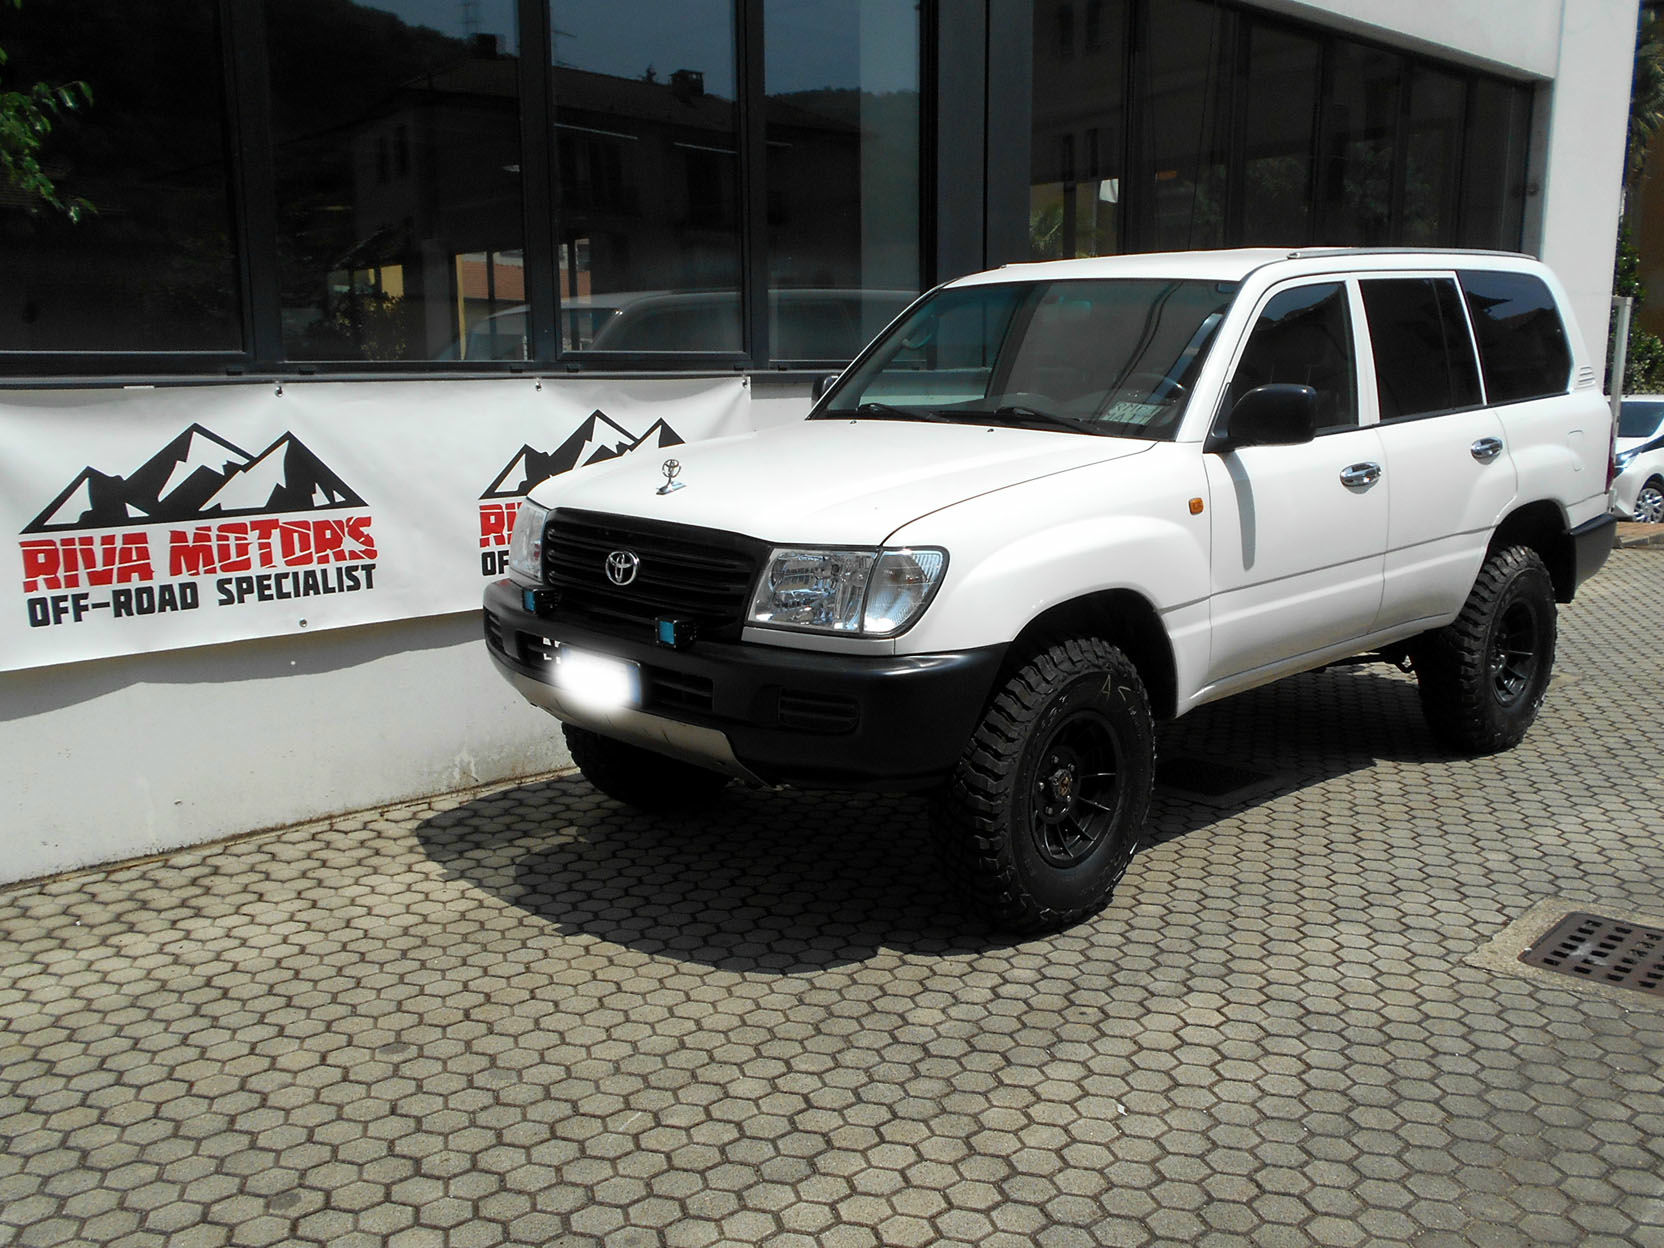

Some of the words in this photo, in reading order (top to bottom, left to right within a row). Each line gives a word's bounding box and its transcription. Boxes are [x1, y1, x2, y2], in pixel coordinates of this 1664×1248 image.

[479, 501, 523, 549] RI
[19, 532, 155, 593] RIVA
[169, 516, 378, 577] MOTORS
[481, 549, 510, 577] OF
[27, 581, 200, 628] OFF-ROAD
[216, 563, 377, 607] SPECIALIST
